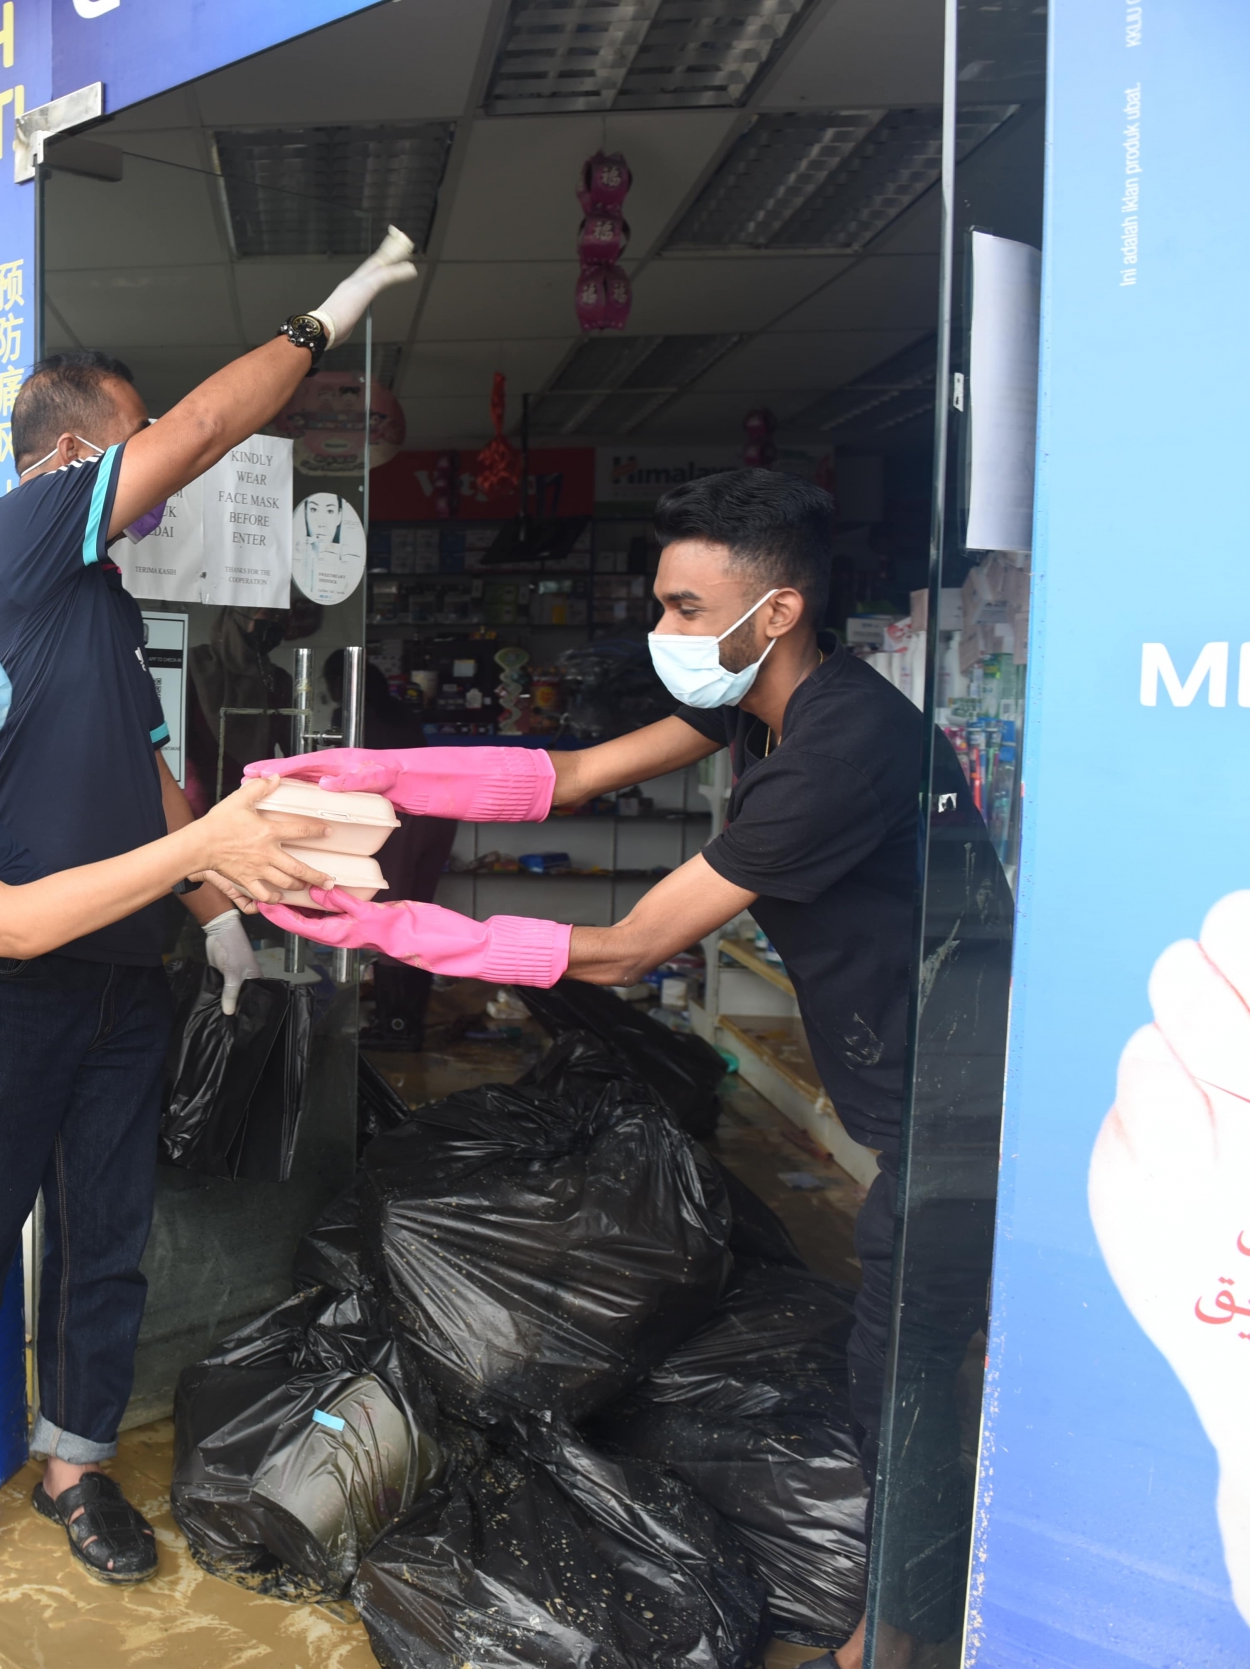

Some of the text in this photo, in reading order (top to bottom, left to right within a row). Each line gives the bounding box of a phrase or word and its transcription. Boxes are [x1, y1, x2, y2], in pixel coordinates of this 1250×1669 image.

[1124, 82, 1142, 120] ubat.
[1122, 123, 1143, 174] produk
[1121, 179, 1140, 213] iklan
[1120, 216, 1139, 264] adalah
[1119, 268, 1137, 287] Ini
[231, 450, 273, 467] KINDLY
[236, 470, 267, 486] WEAR
[218, 490, 280, 509] FACE MASK
[229, 511, 270, 527] BEFORE
[232, 531, 266, 546] ENTER
[135, 565, 177, 575] TERIMA KASIH
[225, 566, 271, 576] THANKS FOR THE
[228, 576, 268, 585] COOPERATION
[1139, 641, 1250, 708] M
